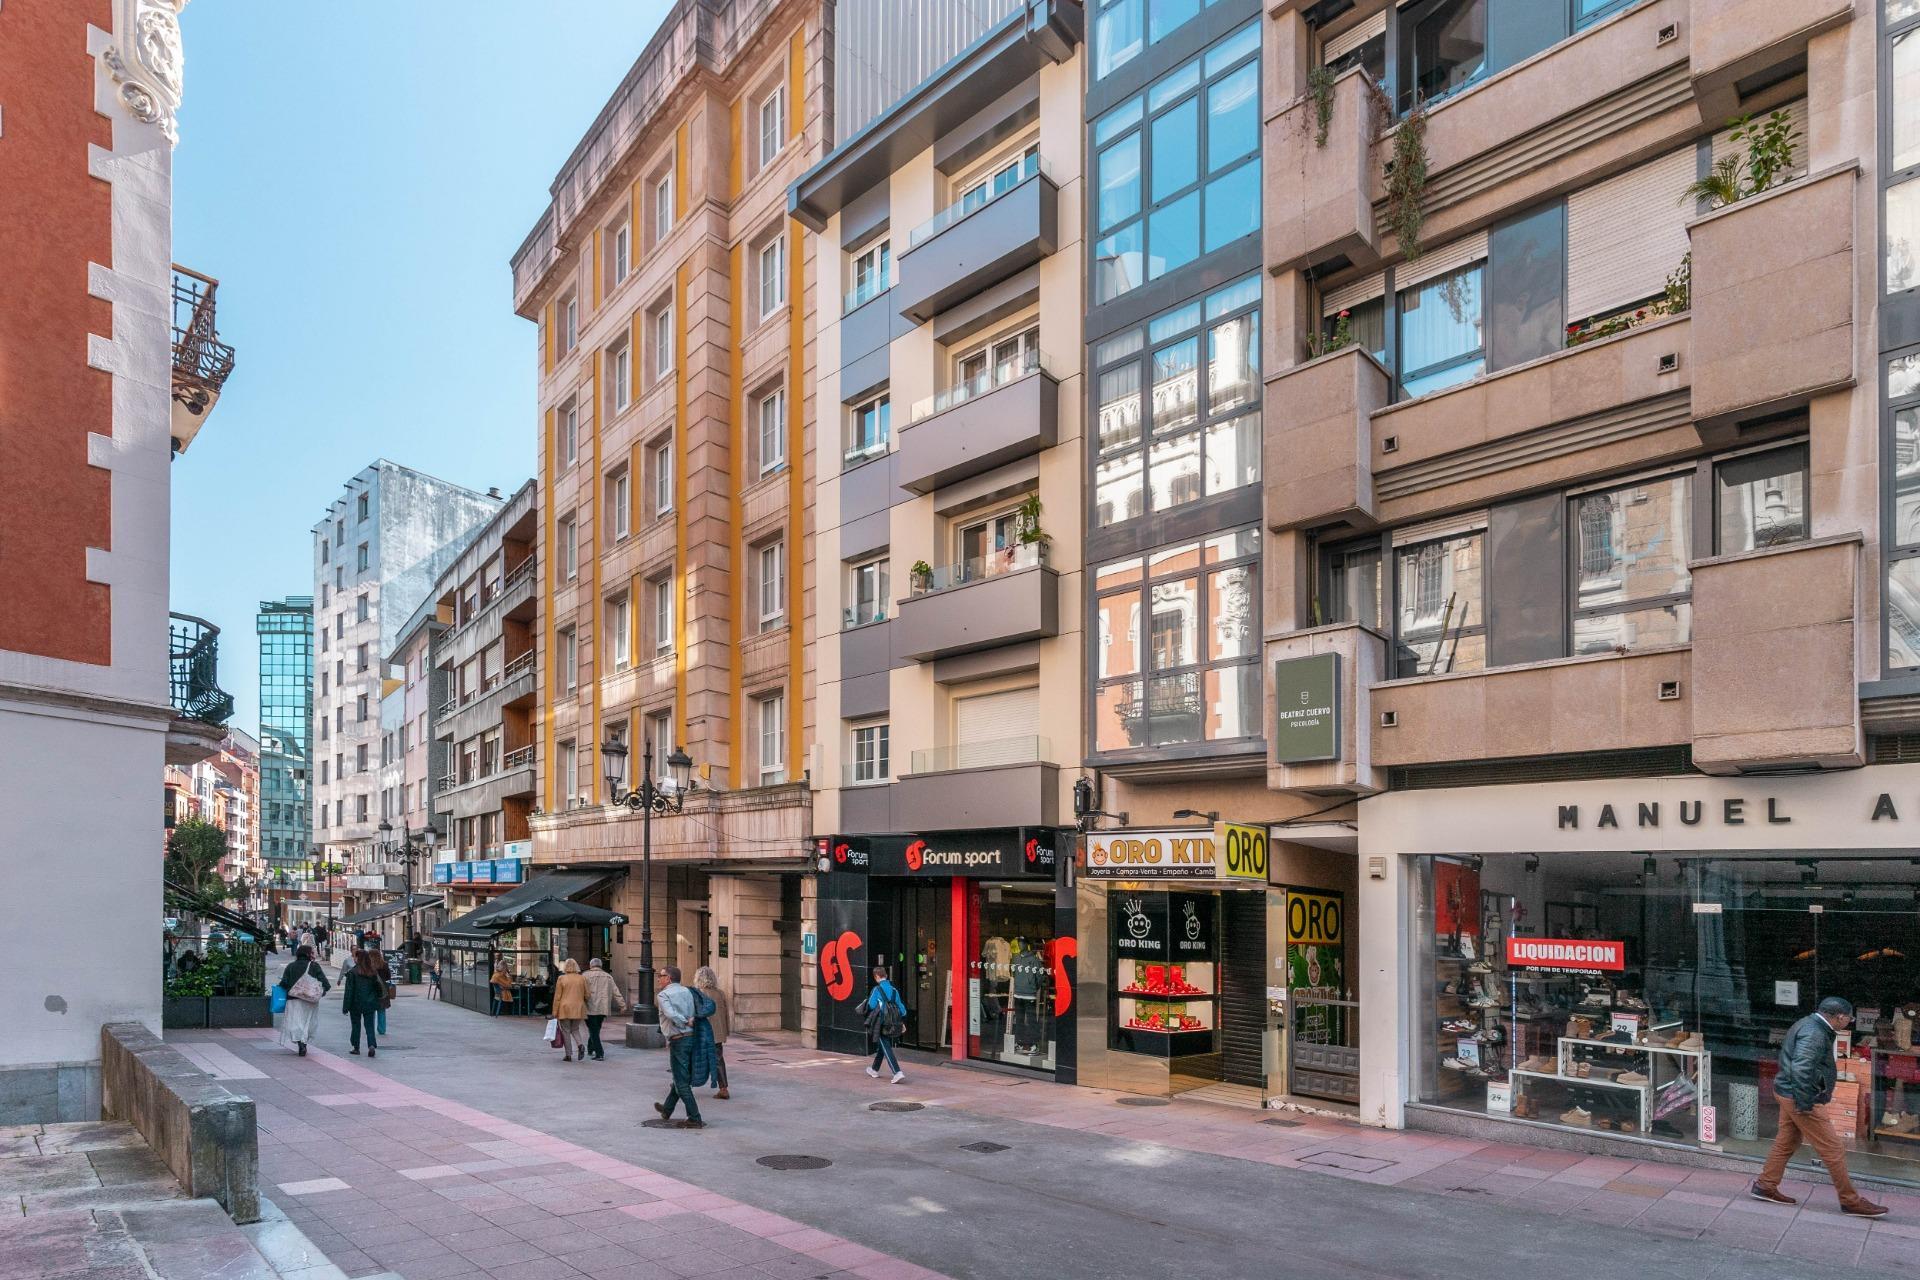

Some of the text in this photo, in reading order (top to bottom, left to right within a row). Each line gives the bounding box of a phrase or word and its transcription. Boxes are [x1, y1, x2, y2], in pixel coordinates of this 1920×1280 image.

[1280, 707, 1330, 719] BEATRIZ CUERVO
[1558, 798, 1792, 828] MANUEL
[922, 848, 1001, 868] forum sport
[1110, 838, 1162, 864] ORO
[1226, 828, 1265, 874] ORO
[1288, 896, 1340, 940] ORO
[1118, 938, 1161, 950] ORO KING
[1180, 940, 1206, 950] ORO KING
[1514, 943, 1616, 962] LIQUIDACION
